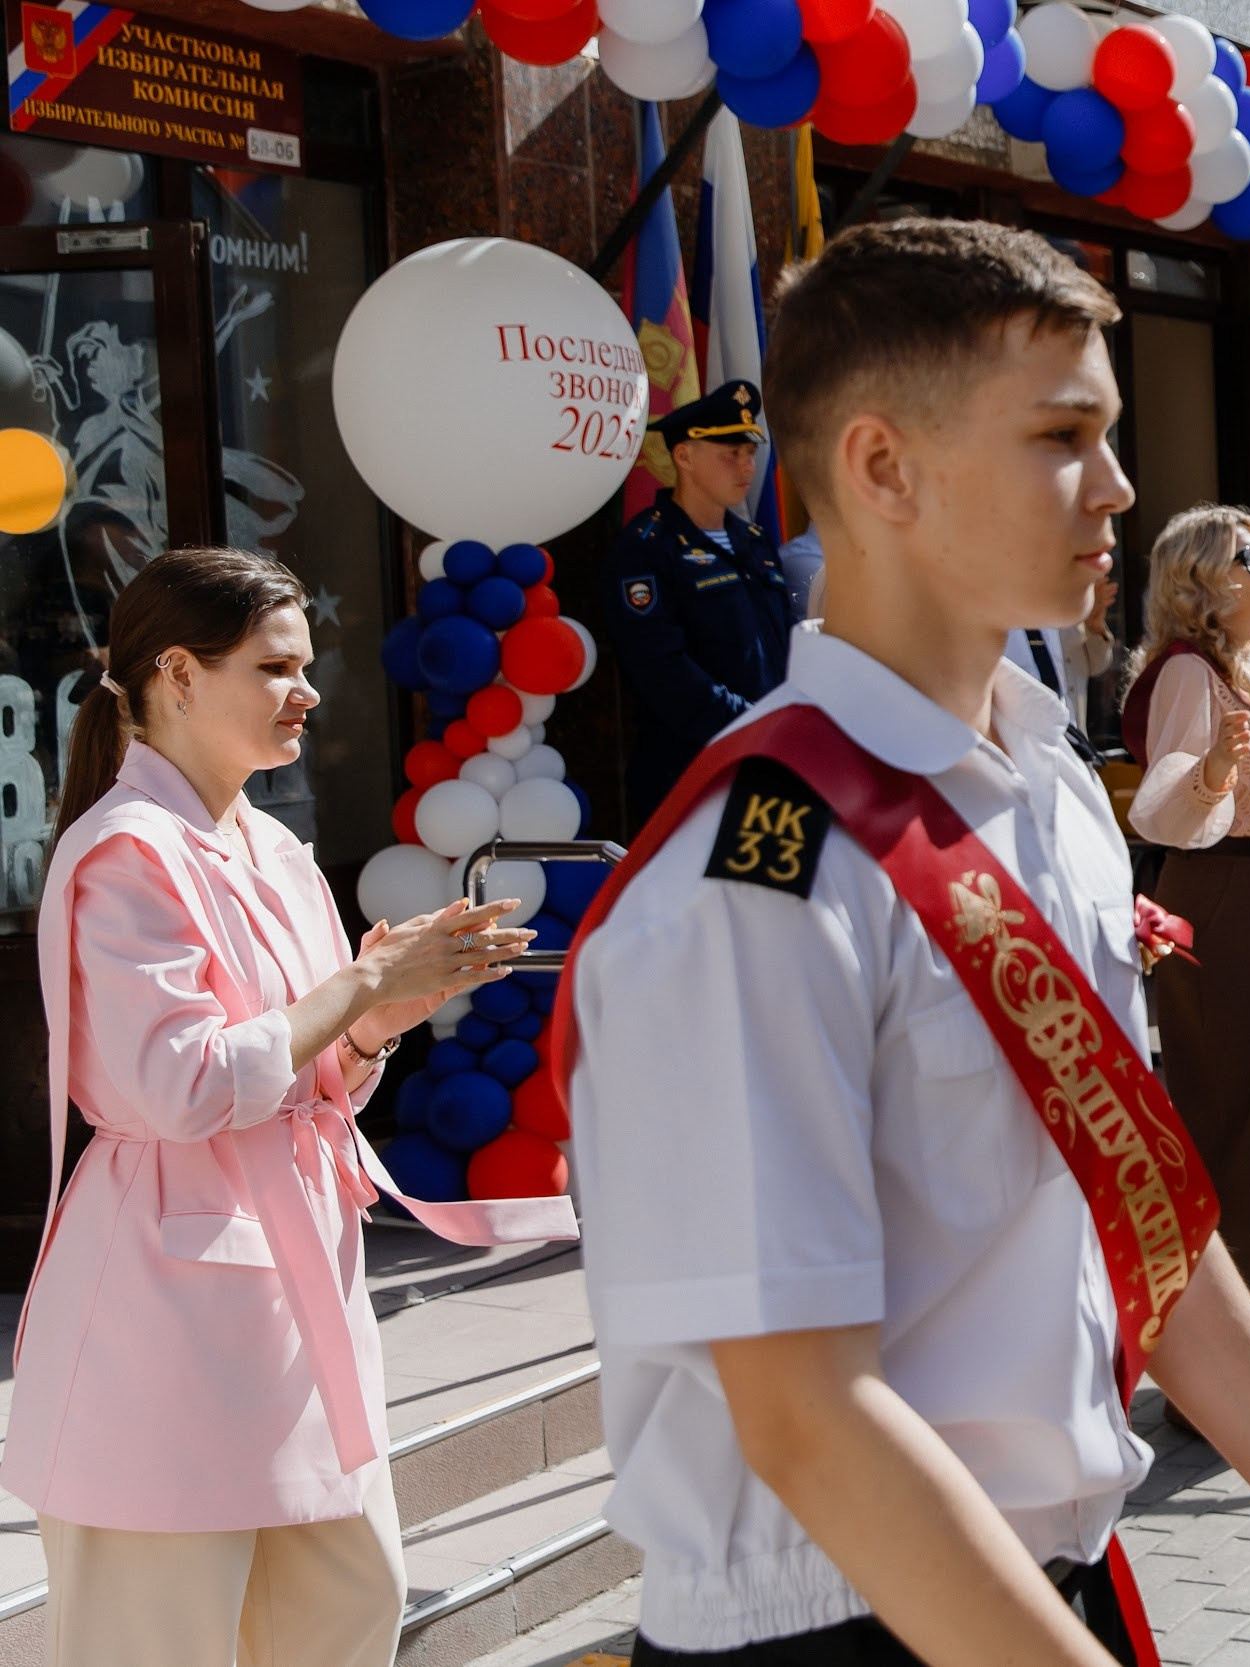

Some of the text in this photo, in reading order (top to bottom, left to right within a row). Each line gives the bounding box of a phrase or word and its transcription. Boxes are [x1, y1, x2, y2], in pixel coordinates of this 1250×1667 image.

[120, 22, 261, 71] УЧАСТКОВАЯ
[97, 46, 285, 101] ИЗБИРАТЕЛЬНАЯ
[24, 98, 160, 137] ИЗБИРАТЕЛЬНОГО
[165, 121, 226, 149] УЧАСТКА
[132, 79, 256, 121] КОМИССИЯ
[209, 231, 309, 274] ОМНИМ!
[725, 830, 805, 881] 33
[992, 936, 1191, 1320] ВЫПУСКНИК
